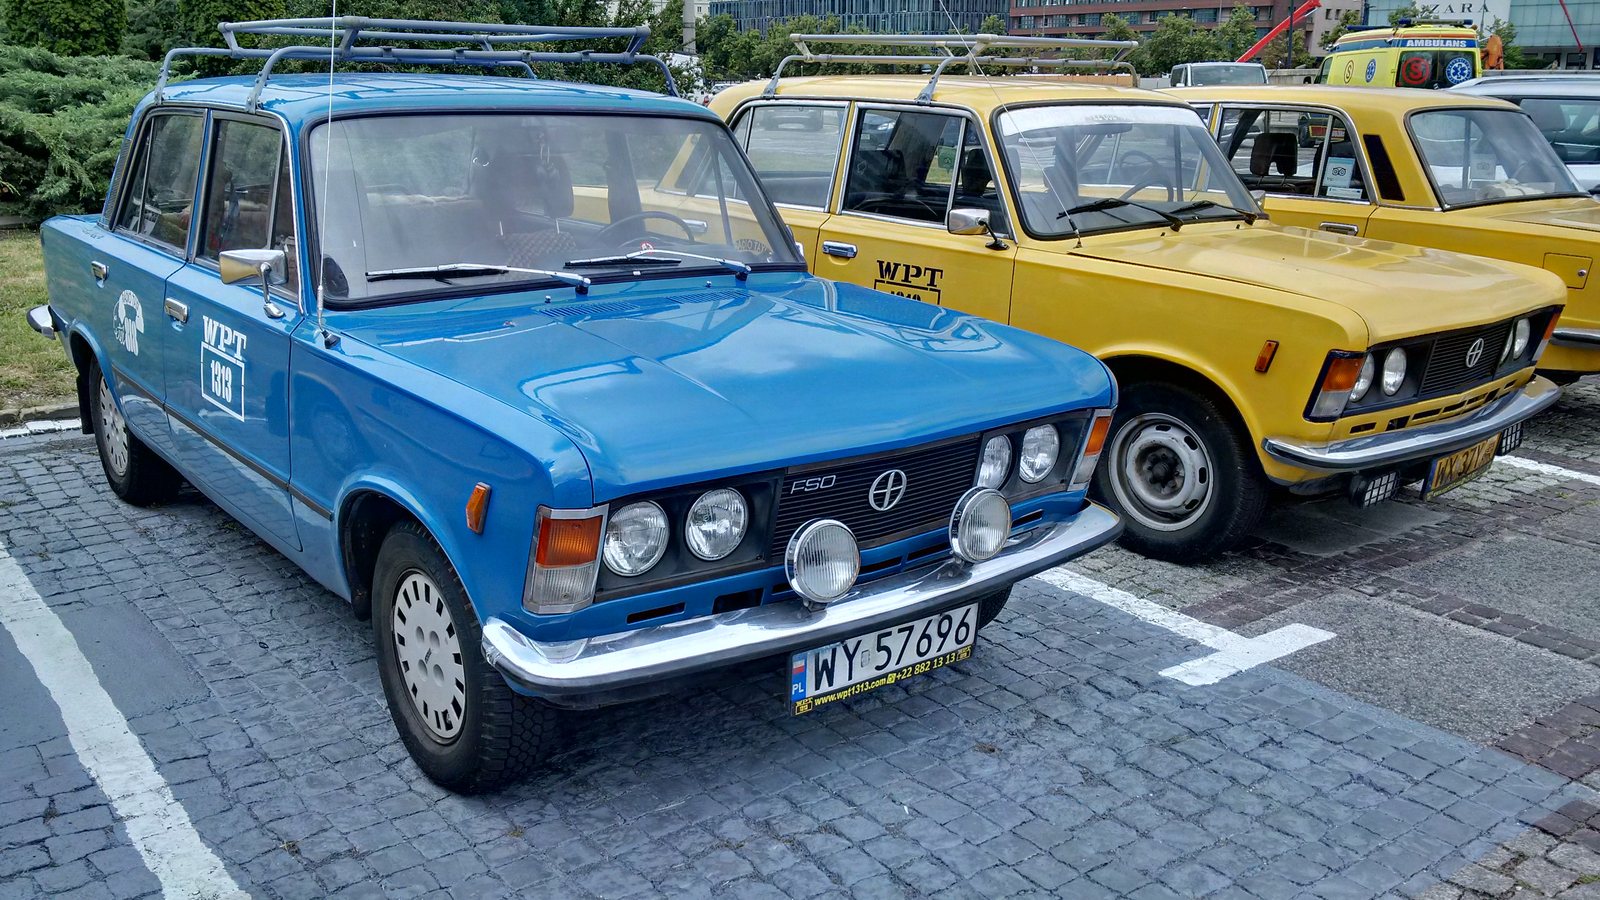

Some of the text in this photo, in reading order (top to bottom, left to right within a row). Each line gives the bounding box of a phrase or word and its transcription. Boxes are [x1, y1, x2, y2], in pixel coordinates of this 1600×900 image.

[1426, 3, 1490, 14] ZARA
[1406, 39, 1467, 48] AMBULANS
[876, 259, 944, 288] WPT
[202, 315, 247, 361] WPT
[210, 359, 232, 403] 1313
[790, 475, 836, 494] FSO
[814, 607, 971, 691] WY 57696
[792, 681, 804, 695] PL
[814, 677, 886, 706] www.wpt1313.com
[914, 661, 931, 675] 882
[932, 657, 944, 669] 13
[945, 652, 956, 665] 13
